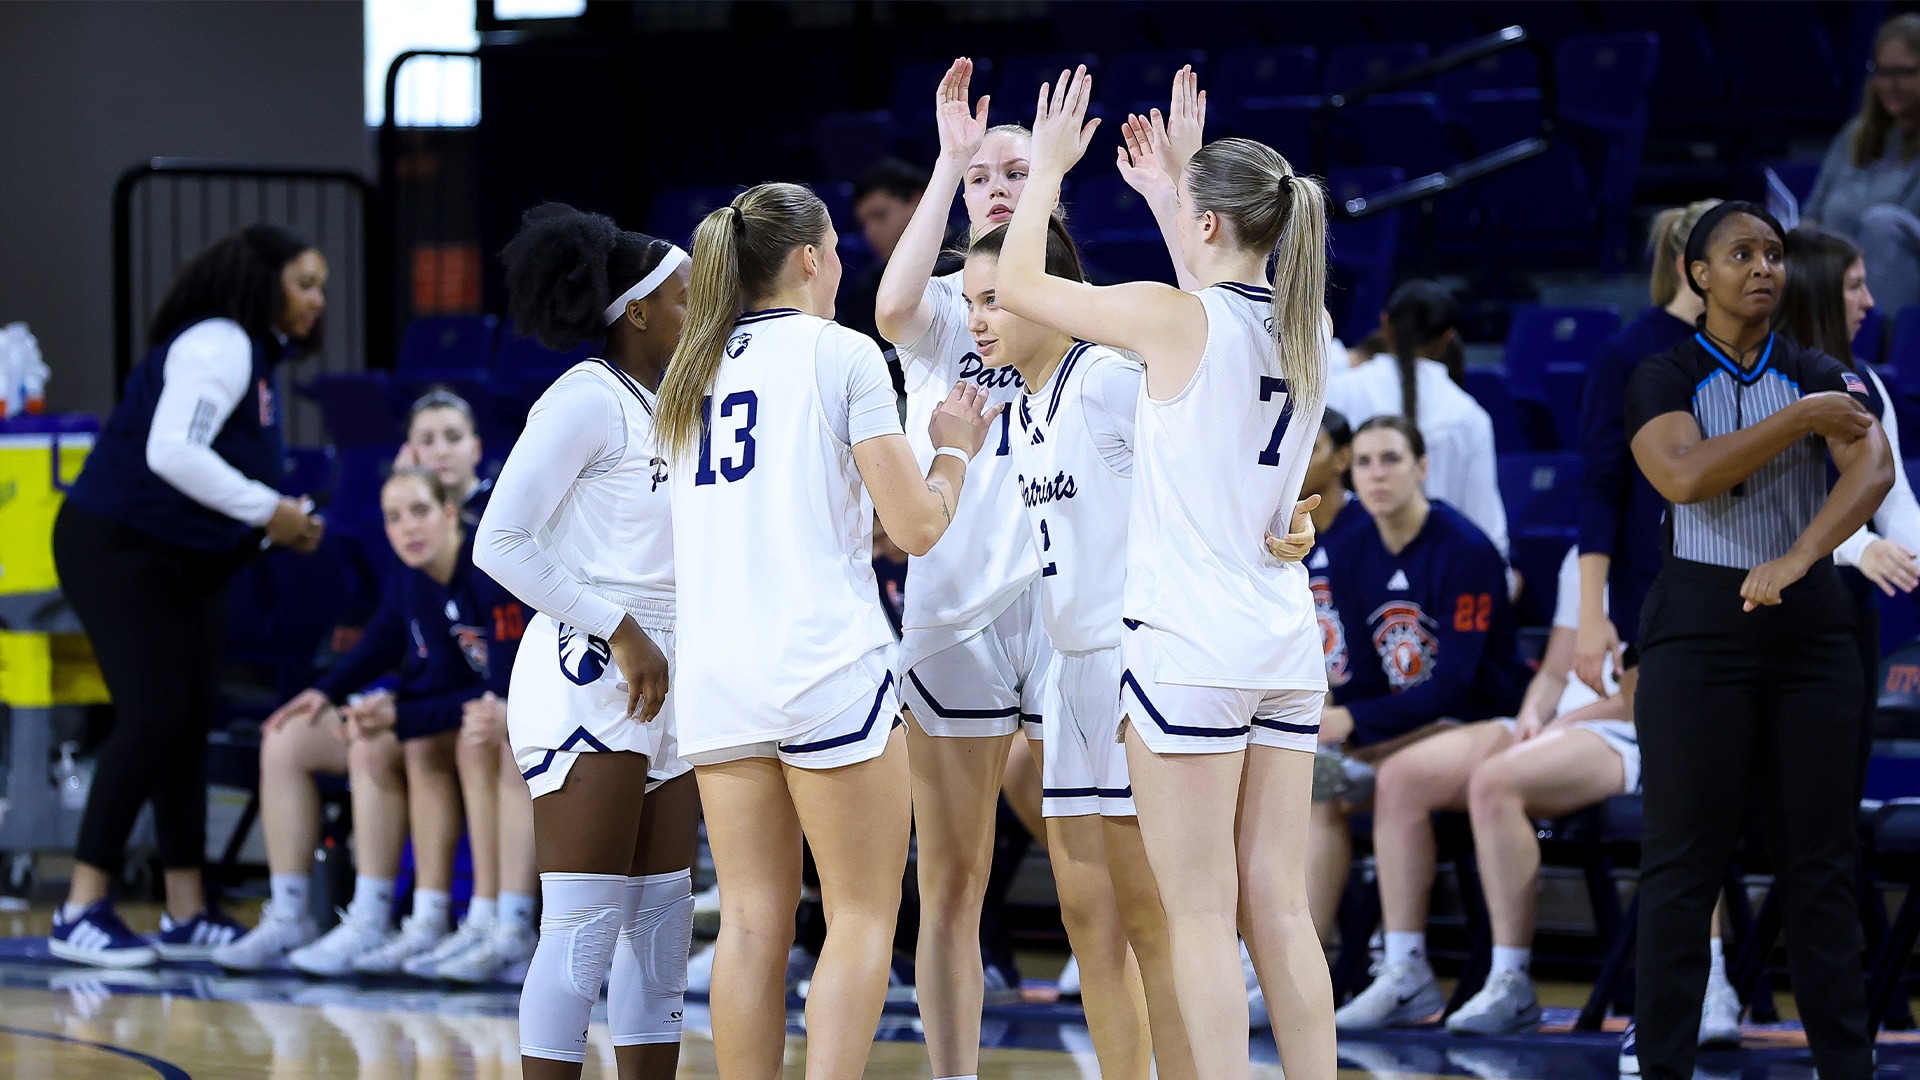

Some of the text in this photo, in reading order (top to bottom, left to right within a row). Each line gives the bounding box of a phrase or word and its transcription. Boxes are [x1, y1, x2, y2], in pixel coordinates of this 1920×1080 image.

[695, 390, 758, 487] 13
[1258, 375, 1294, 467] 7
[492, 602, 525, 643] 10
[1453, 592, 1493, 633] 22
